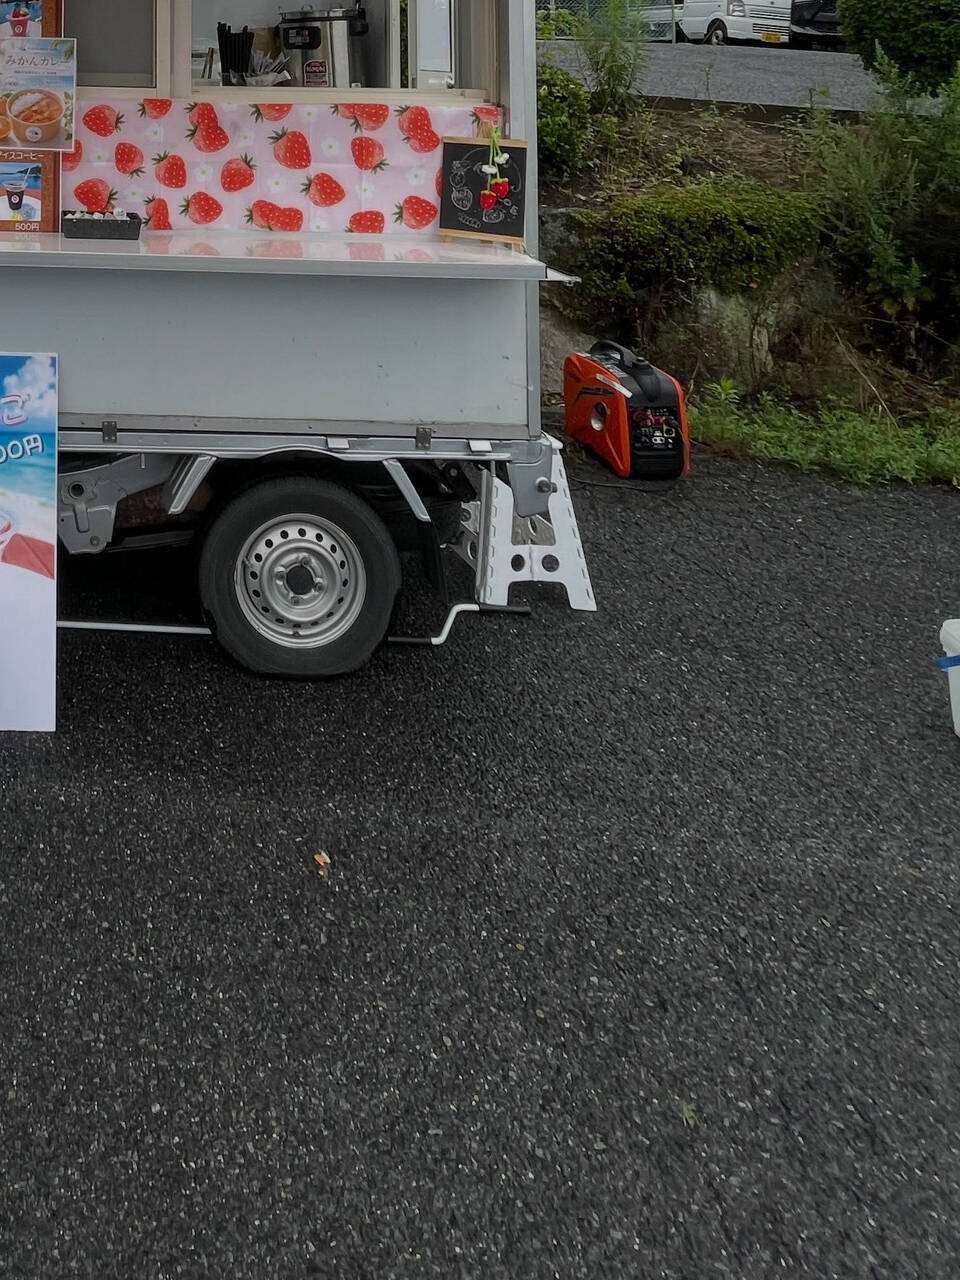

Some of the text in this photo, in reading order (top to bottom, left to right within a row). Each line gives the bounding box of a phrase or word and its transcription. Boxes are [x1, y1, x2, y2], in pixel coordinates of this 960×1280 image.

[6, 55, 70, 66] みかんカレー
